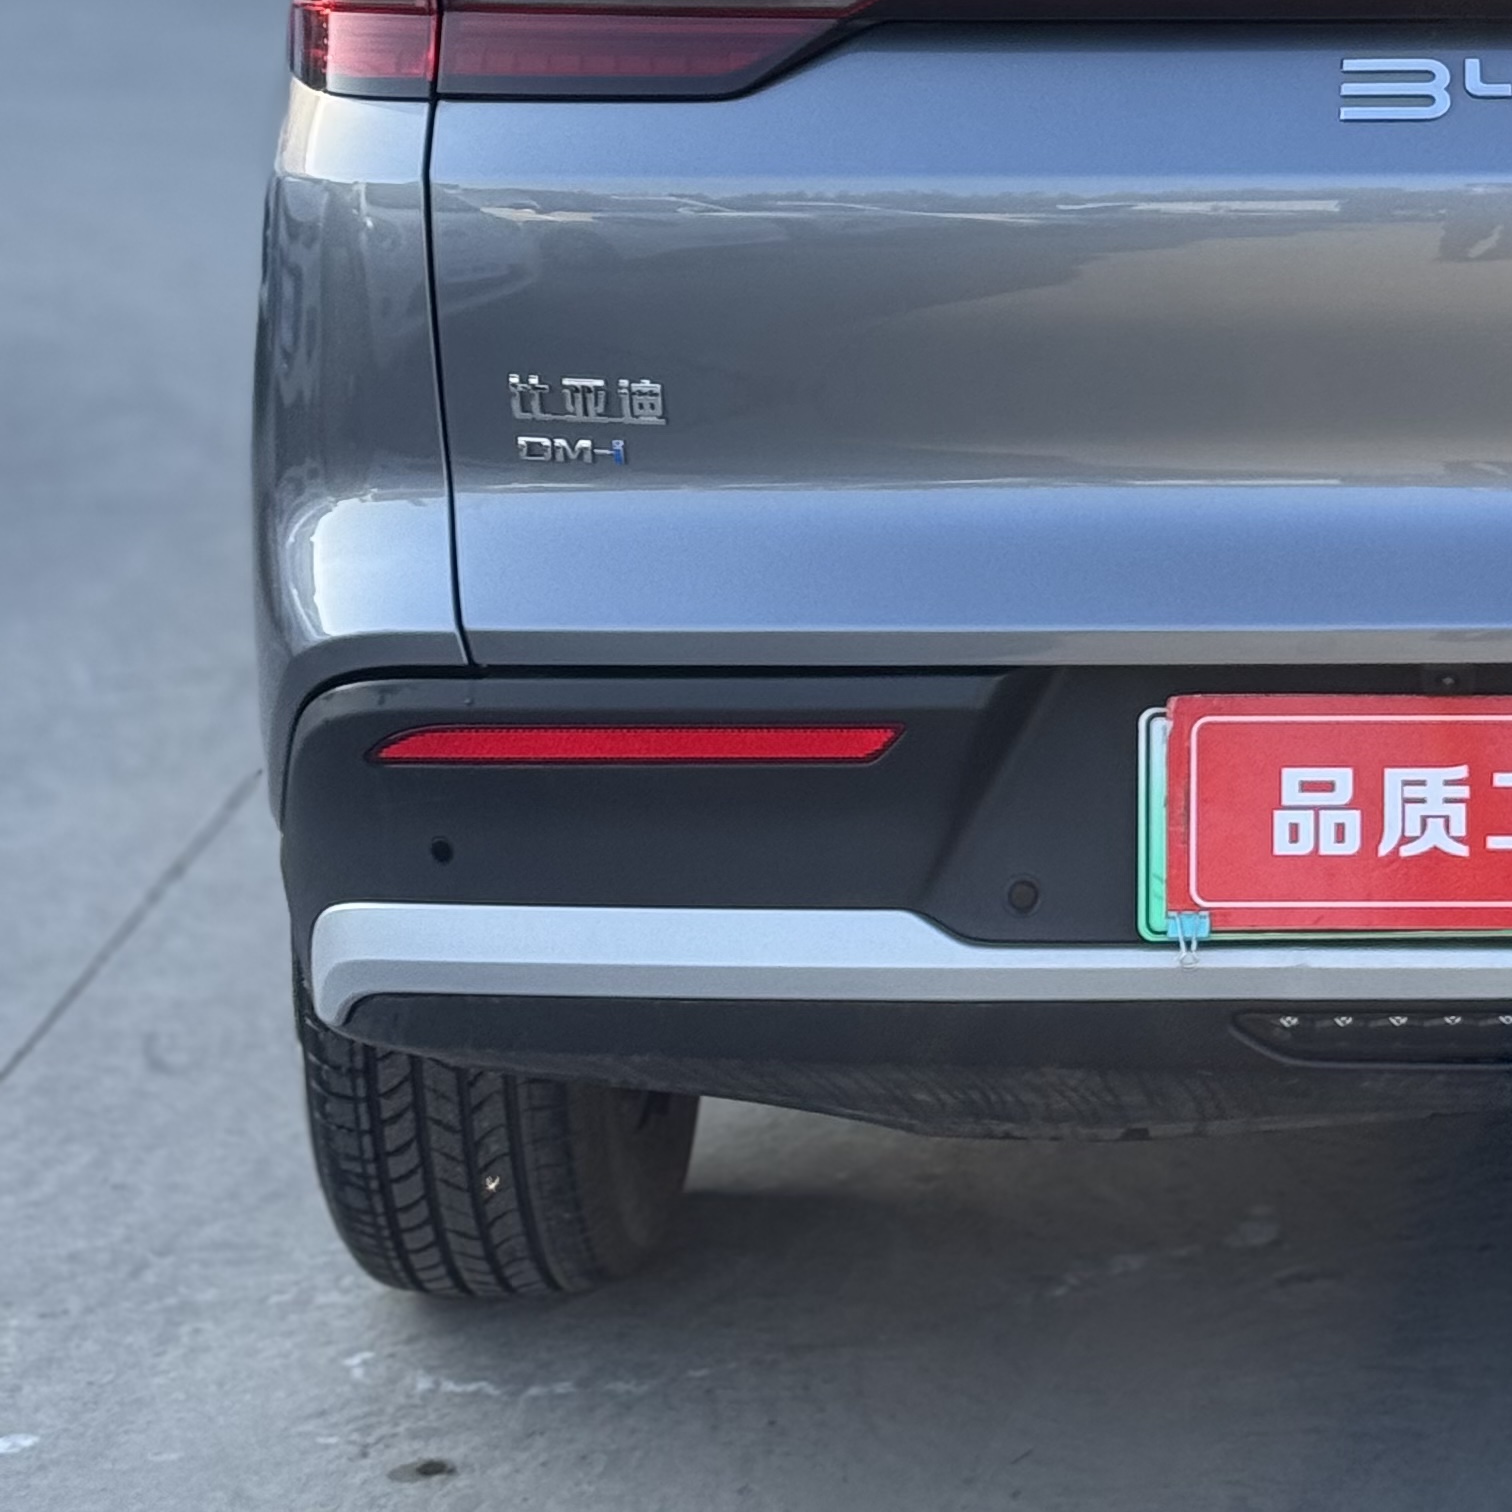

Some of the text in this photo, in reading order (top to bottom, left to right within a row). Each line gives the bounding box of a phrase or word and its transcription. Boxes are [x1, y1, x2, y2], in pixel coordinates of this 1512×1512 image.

[508, 373, 667, 426] 比亚迪
[517, 436, 626, 465] DM-i
